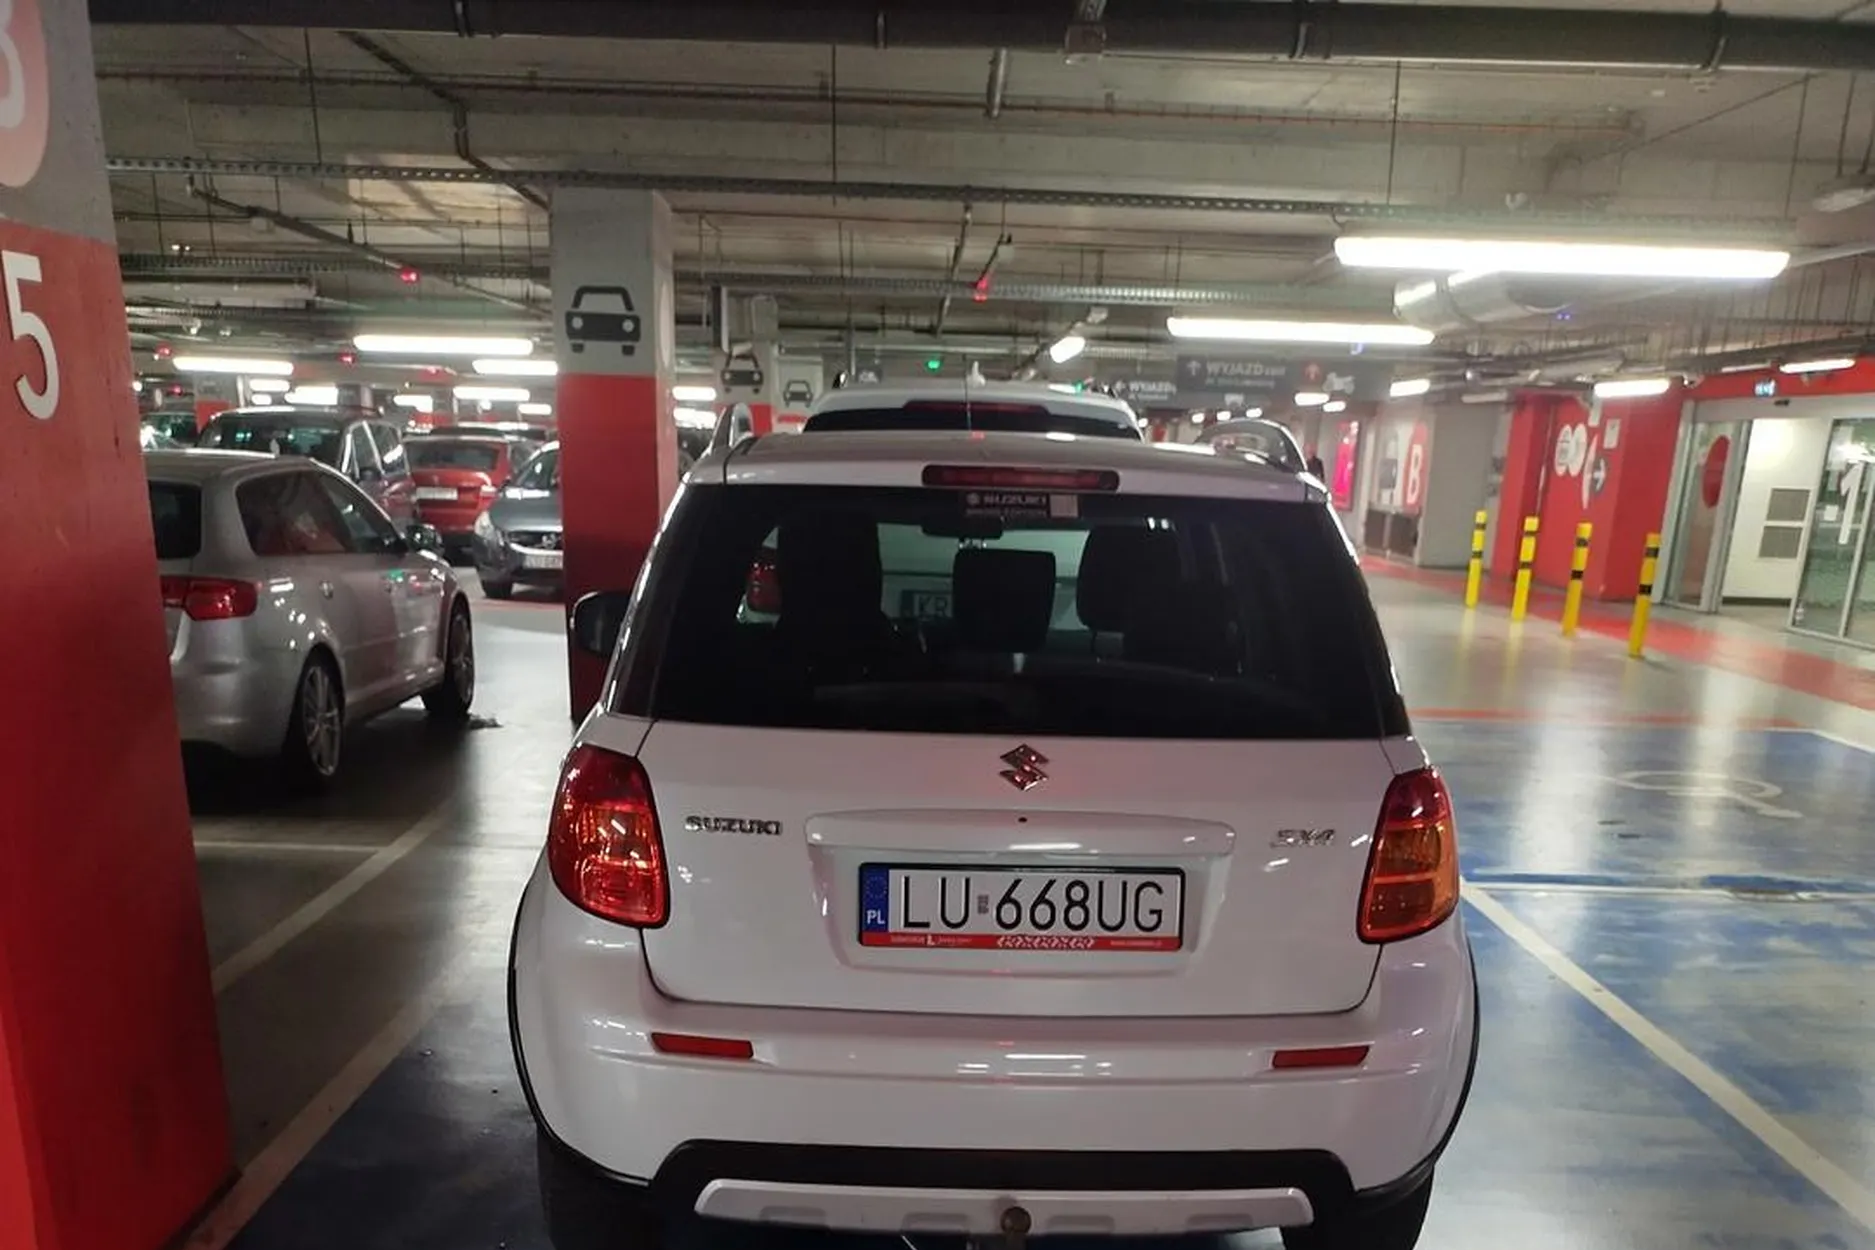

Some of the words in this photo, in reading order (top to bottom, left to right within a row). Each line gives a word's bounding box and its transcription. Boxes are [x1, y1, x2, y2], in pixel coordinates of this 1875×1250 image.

[2, 249, 60, 421] 5
[1406, 443, 1423, 505] B
[1838, 461, 1866, 545] 1
[684, 815, 782, 836] SUZUKI
[866, 909, 886, 925] PL
[902, 875, 970, 930] LU
[994, 878, 1164, 932] 668UG
